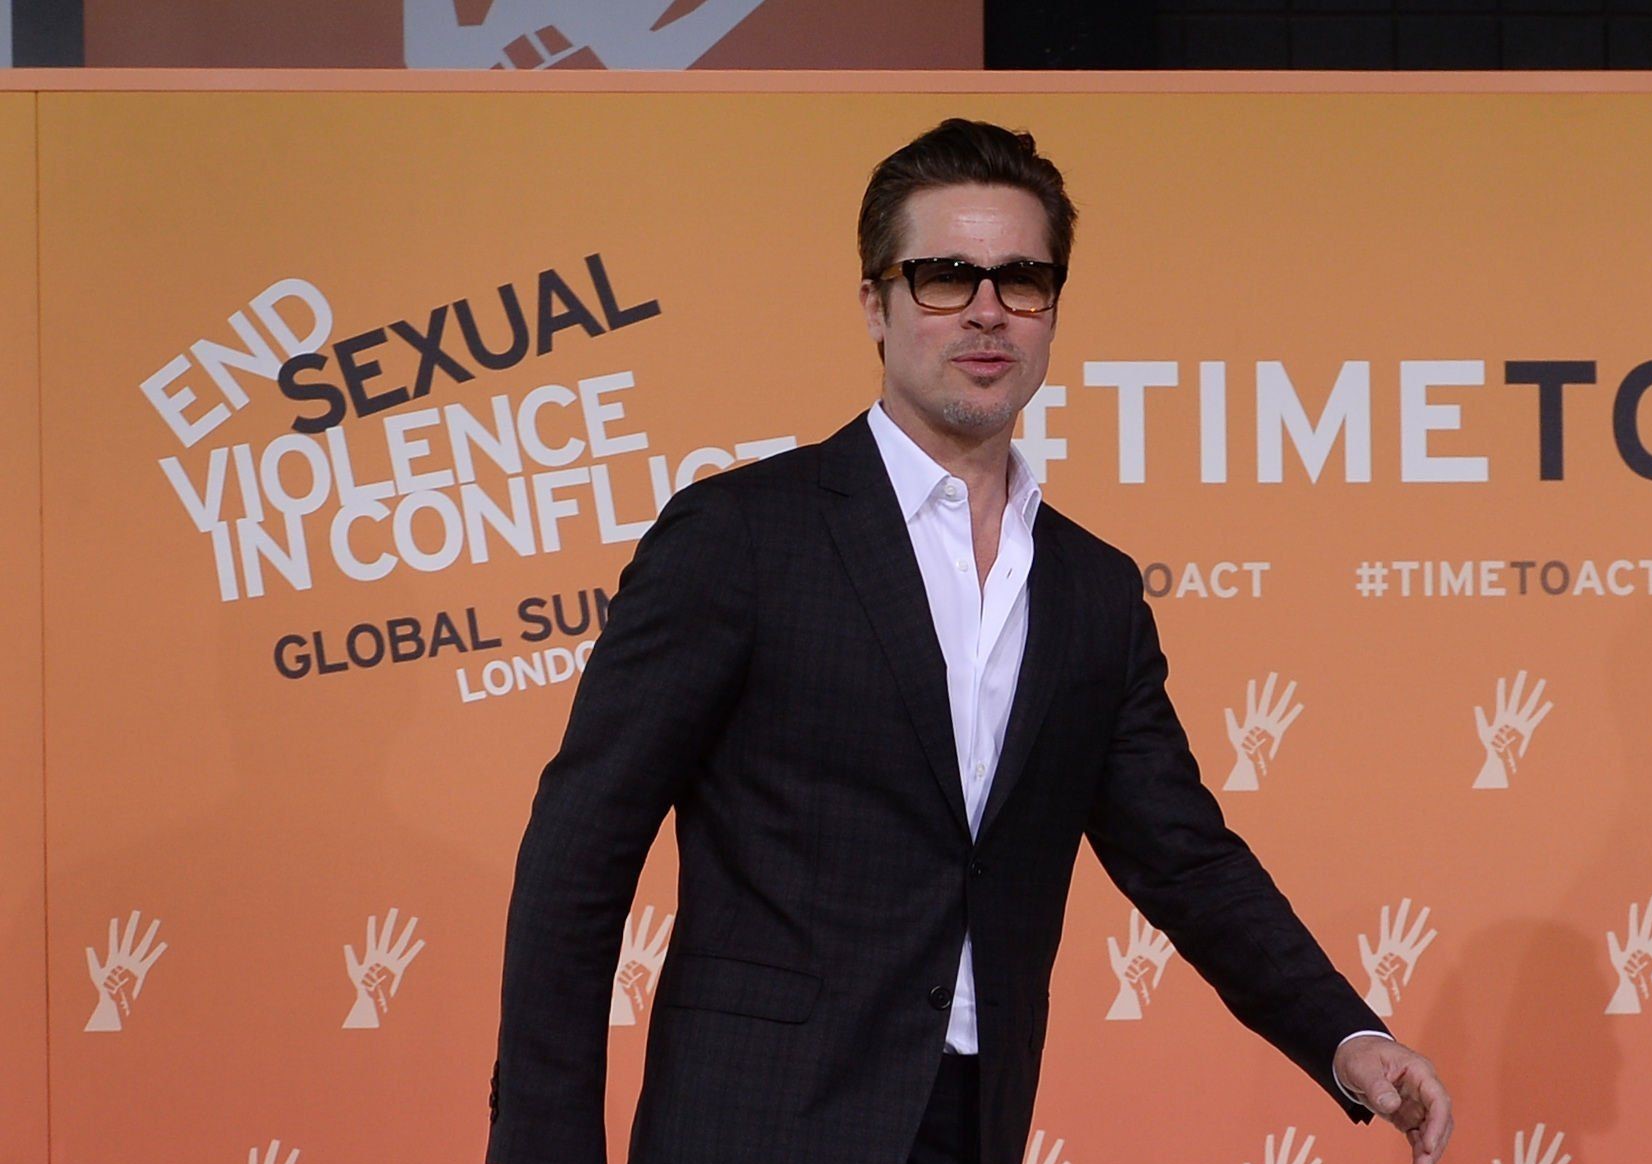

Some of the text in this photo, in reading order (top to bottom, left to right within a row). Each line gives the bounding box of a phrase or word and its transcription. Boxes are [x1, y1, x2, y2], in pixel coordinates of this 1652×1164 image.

[139, 253, 661, 448] END SEXUAL
[159, 371, 649, 533] VIOLENCE
[211, 510, 312, 602] IN
[273, 607, 501, 680] GLOBAL
